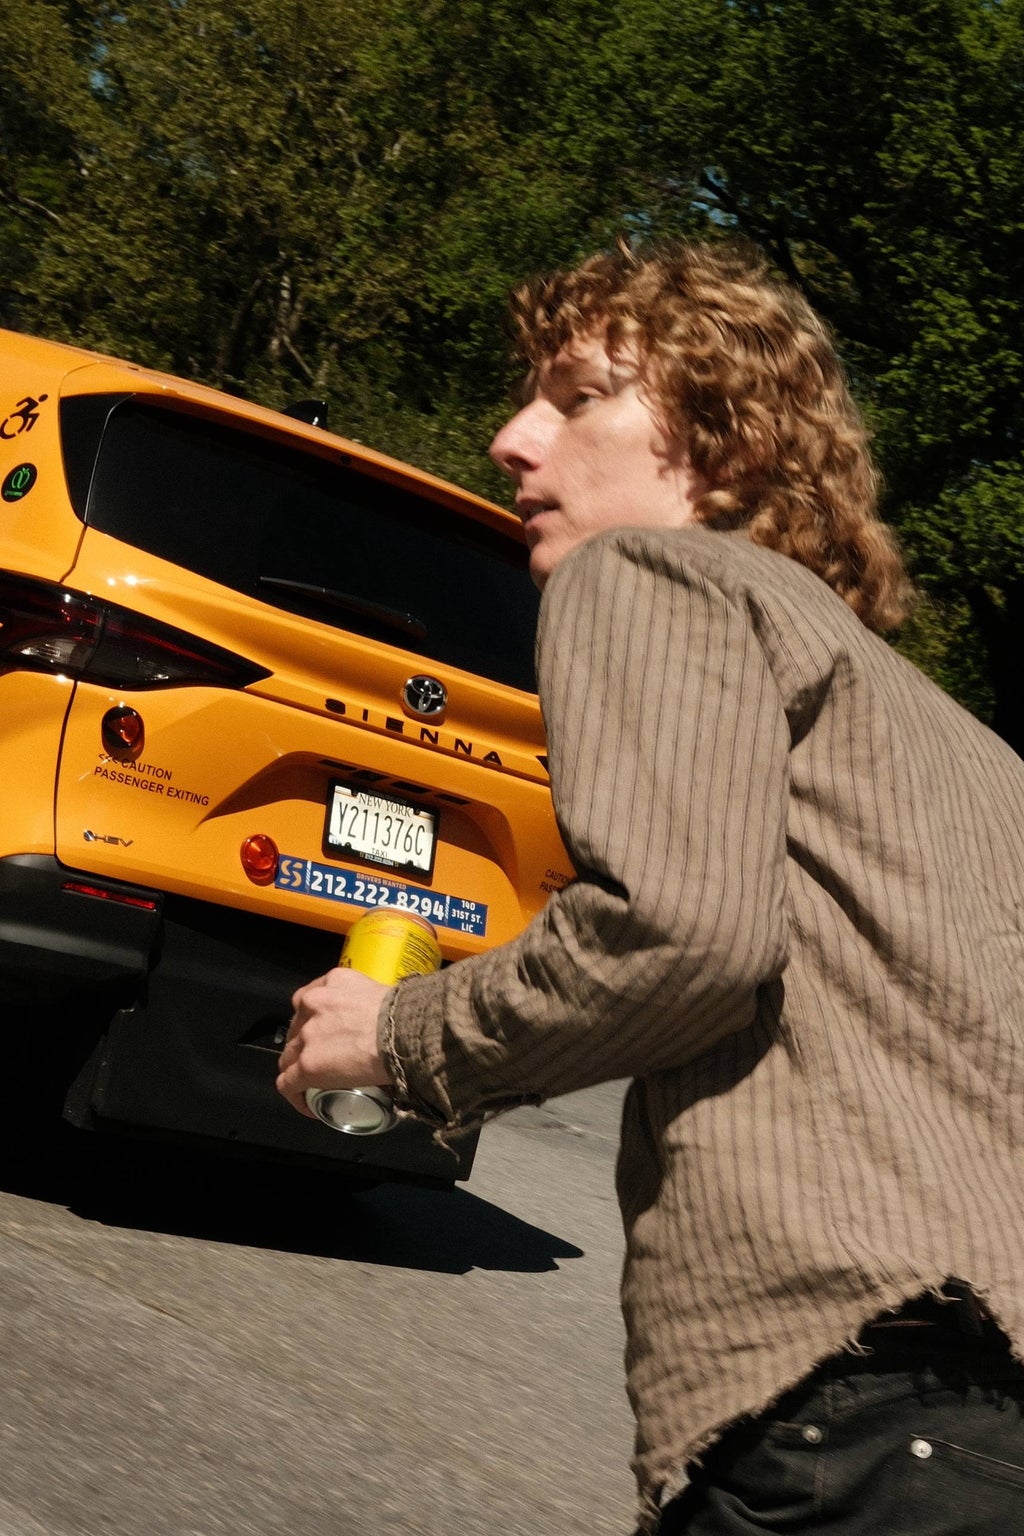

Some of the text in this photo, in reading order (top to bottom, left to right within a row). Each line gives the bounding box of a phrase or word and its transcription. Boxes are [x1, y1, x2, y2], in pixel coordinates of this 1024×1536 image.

[325, 698, 502, 766] SIENNA
[121, 758, 172, 780] CAUTION
[94, 766, 210, 806] PASSENGER EXITING
[359, 794, 382, 808] NEW
[385, 799, 411, 817] YORK
[339, 801, 425, 856] Y211376C
[371, 847, 388, 858] TAXI
[356, 872, 407, 890] DRIVERS WANTED
[461, 899, 476, 911] 140
[451, 908, 483, 925] 31ST ST.
[461, 922, 474, 934] LIC
